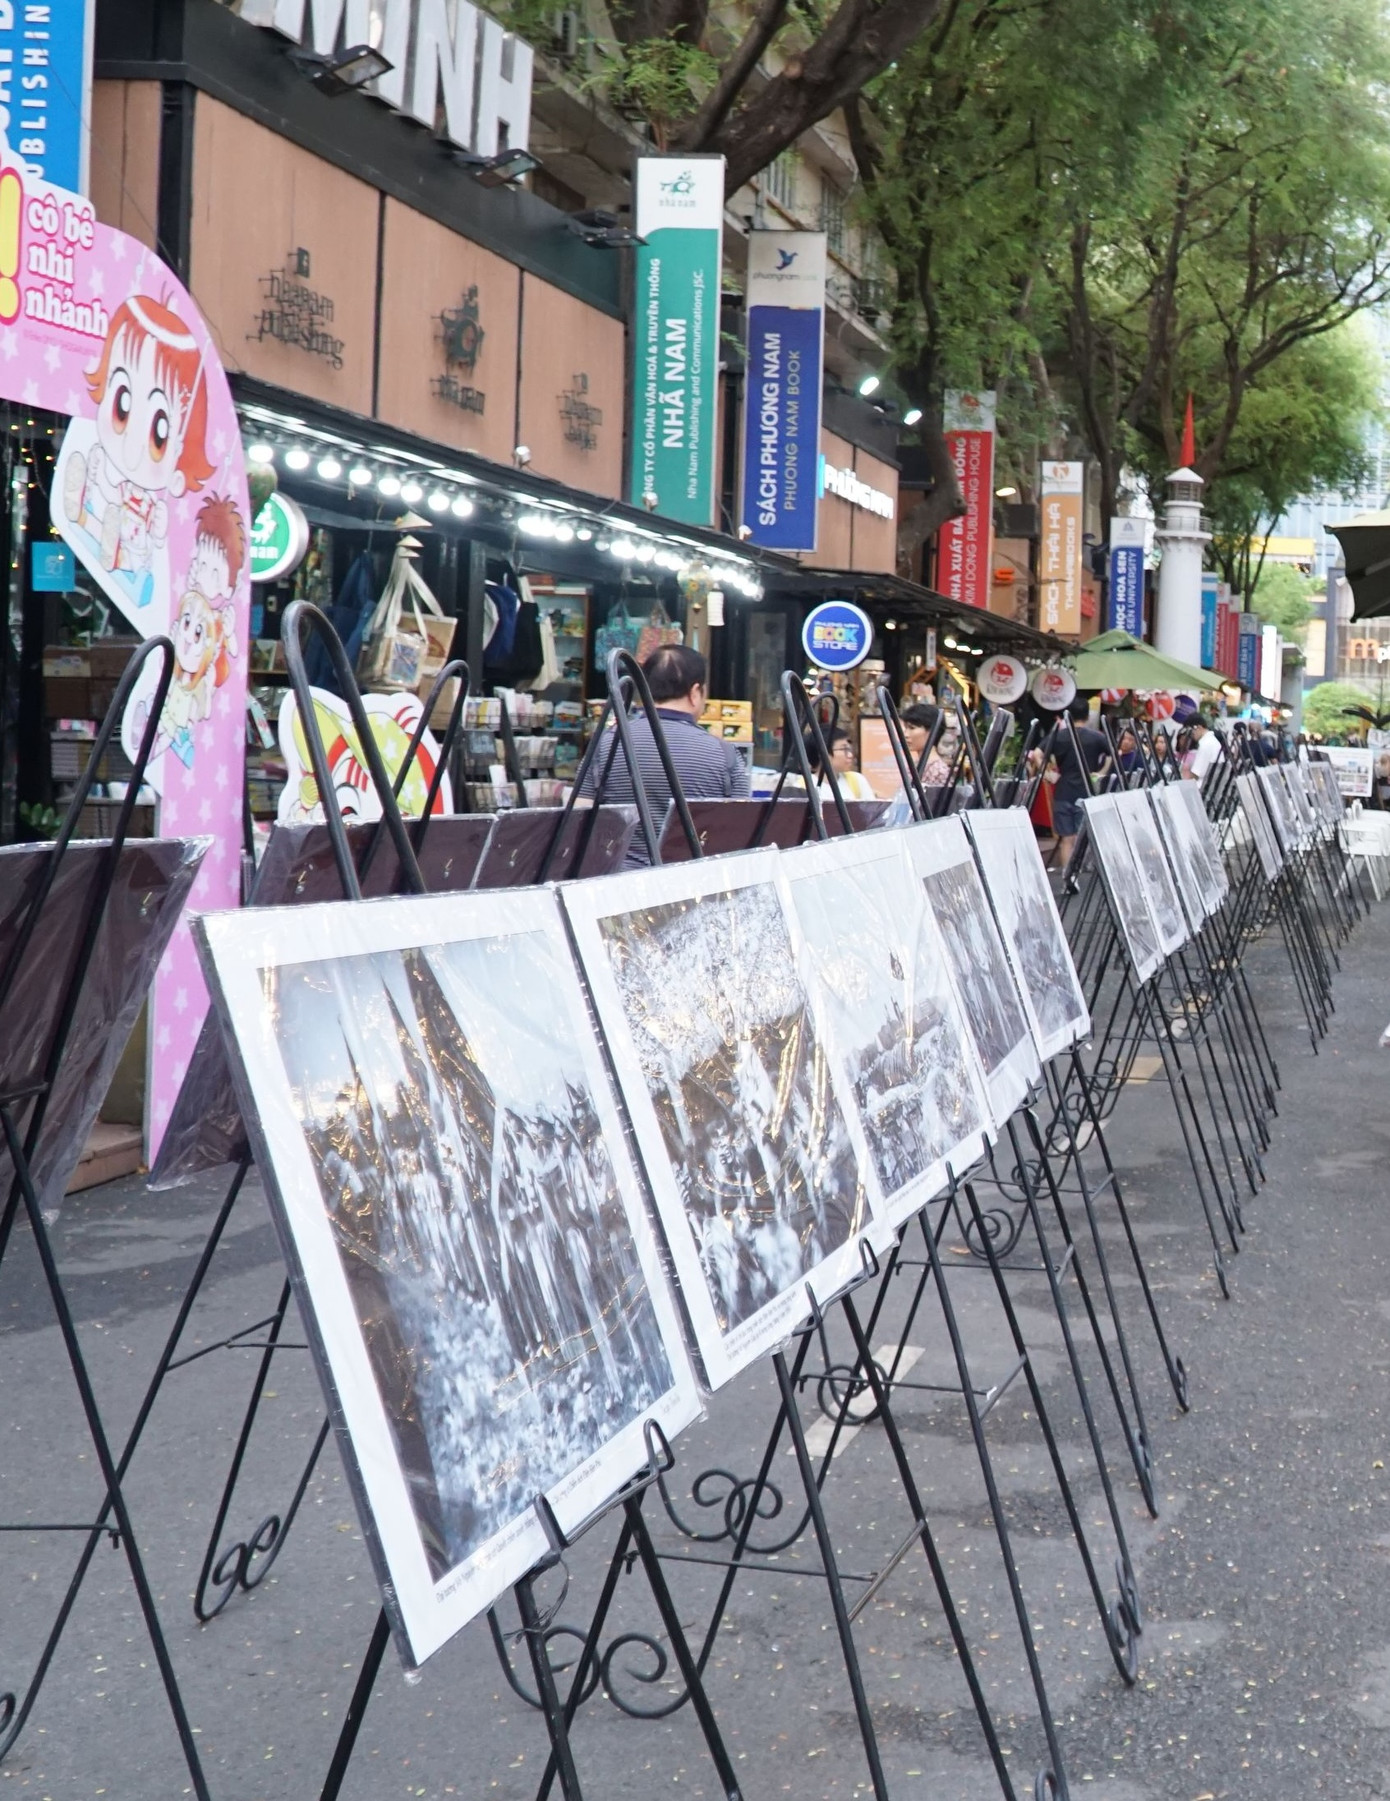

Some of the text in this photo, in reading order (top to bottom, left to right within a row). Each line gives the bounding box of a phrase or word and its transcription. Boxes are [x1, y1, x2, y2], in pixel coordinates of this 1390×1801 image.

[28, 194, 59, 236] cô
[647, 258, 661, 298] THÔNG
[25, 284, 109, 339] nhảnh
[690, 289, 703, 374] Communications
[647, 345, 658, 354] &
[645, 355, 658, 381] HOÁ
[658, 318, 687, 448] NHÃ NAM
[690, 376, 701, 396] and
[688, 398, 702, 450] Publishing
[756, 333, 781, 526] SÁCH PHƯƠNG NAM
[783, 350, 801, 510] PHUONG NAM BOOK
[644, 459, 655, 473] TY
[688, 451, 699, 476] Nam
[687, 478, 698, 499] Nha
[964, 437, 981, 604] KIM DONG PUBLISHING HOUSE
[1117, 551, 1128, 574] SEN
[1127, 551, 1138, 607] UNIVERSITY
[1116, 576, 1127, 602] HOA
[813, 640, 859, 650] STORE
[814, 626, 858, 643] BOOK
